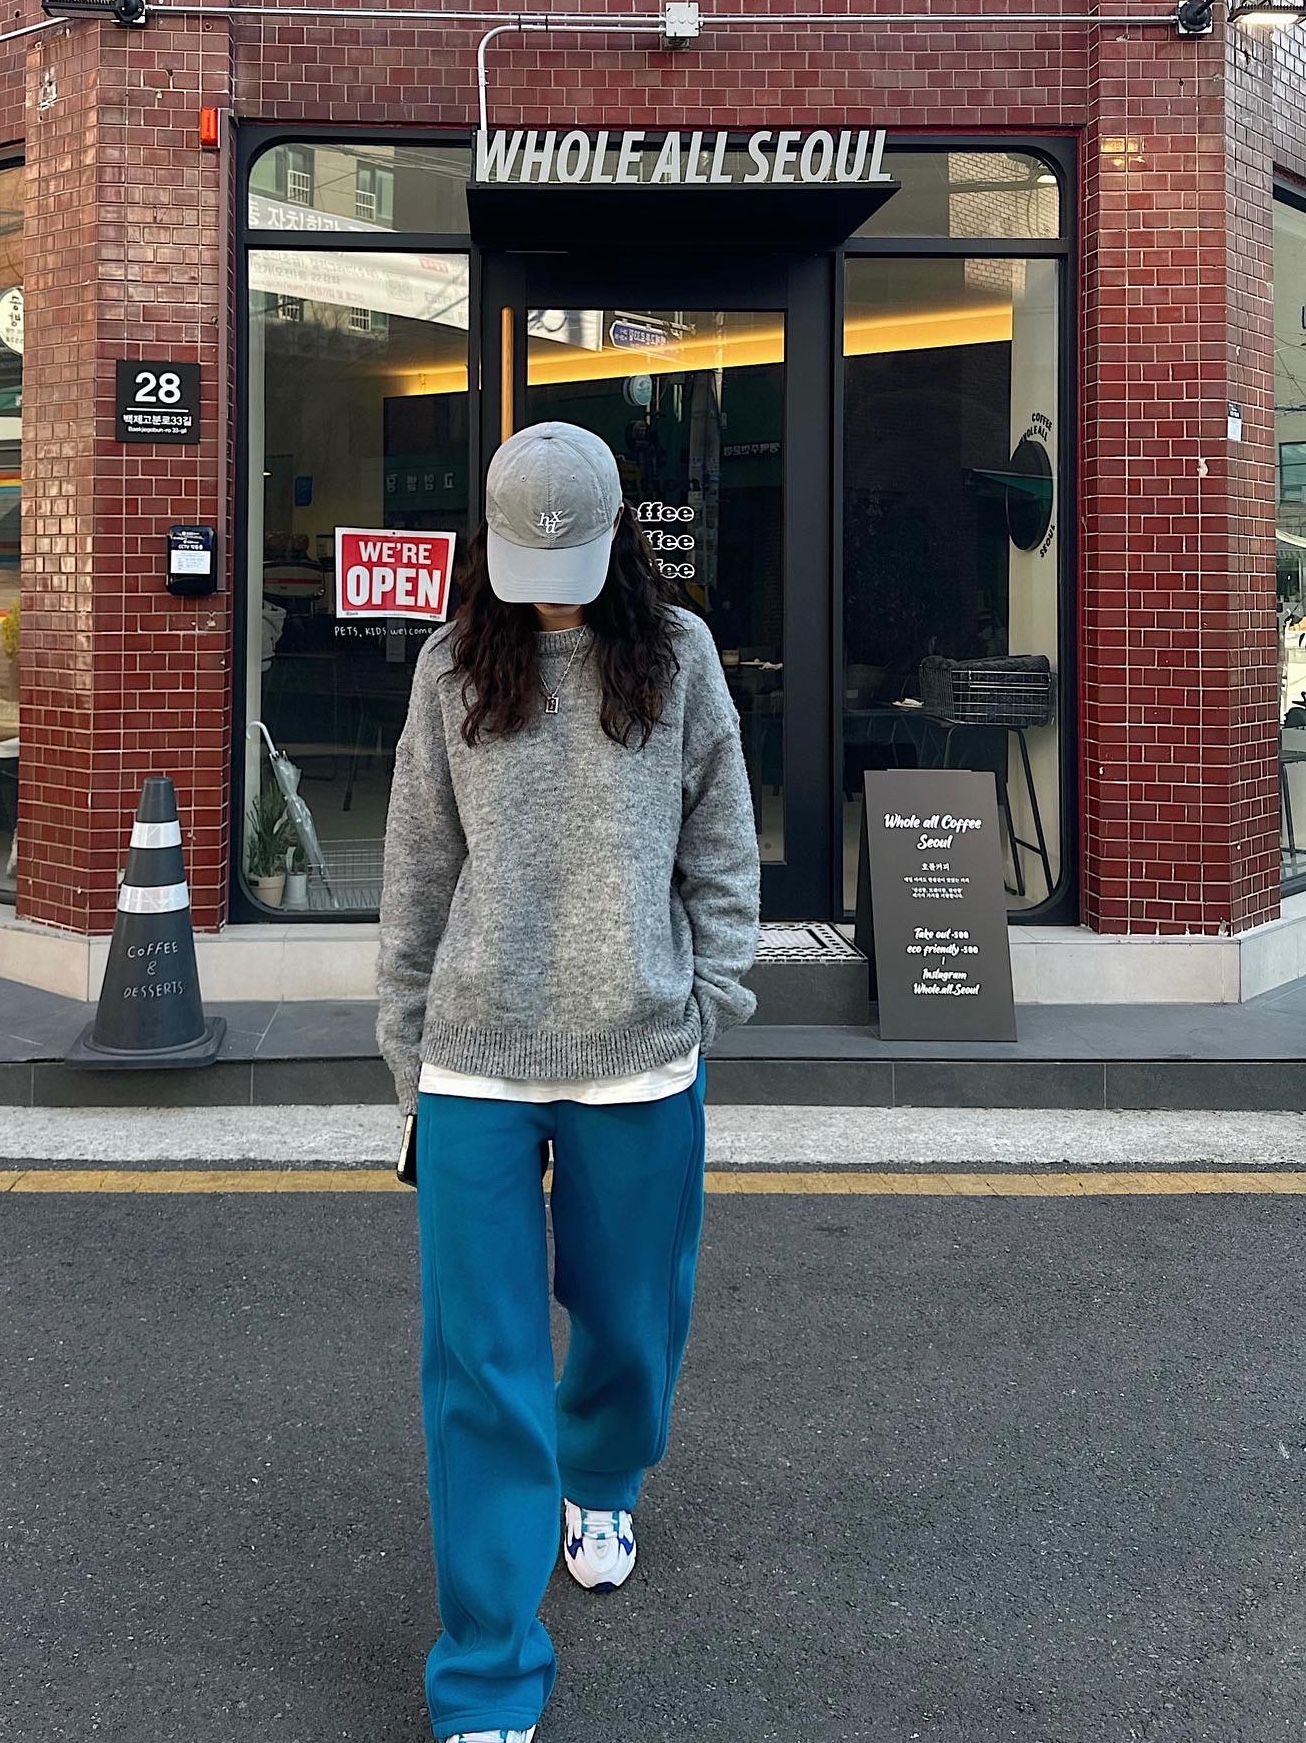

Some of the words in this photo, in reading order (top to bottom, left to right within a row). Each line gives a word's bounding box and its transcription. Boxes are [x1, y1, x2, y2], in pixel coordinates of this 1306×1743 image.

[475, 130, 645, 183] WHOLE
[649, 131, 732, 183] ALL
[743, 130, 894, 182] SEOUL
[135, 371, 181, 404] 28
[123, 414, 192, 427] 백제고분로33길
[1032, 412, 1053, 431] COFFEE
[637, 502, 694, 521] ffee
[1040, 524, 1055, 558] SEOUL
[359, 541, 432, 564] WE'RE
[347, 565, 441, 608] OPEN
[365, 627, 387, 636] KIDS
[884, 814, 920, 828] Whole
[922, 815, 940, 829] all
[941, 815, 982, 833] Coffee
[917, 834, 953, 850] Seoul
[914, 927, 934, 940] Take
[127, 941, 179, 959] COFFEE
[906, 945, 922, 954] eco
[923, 943, 959, 957] friendly
[147, 961, 157, 976] &
[922, 968, 967, 982] Instagram
[123, 981, 184, 999] DESSERTS
